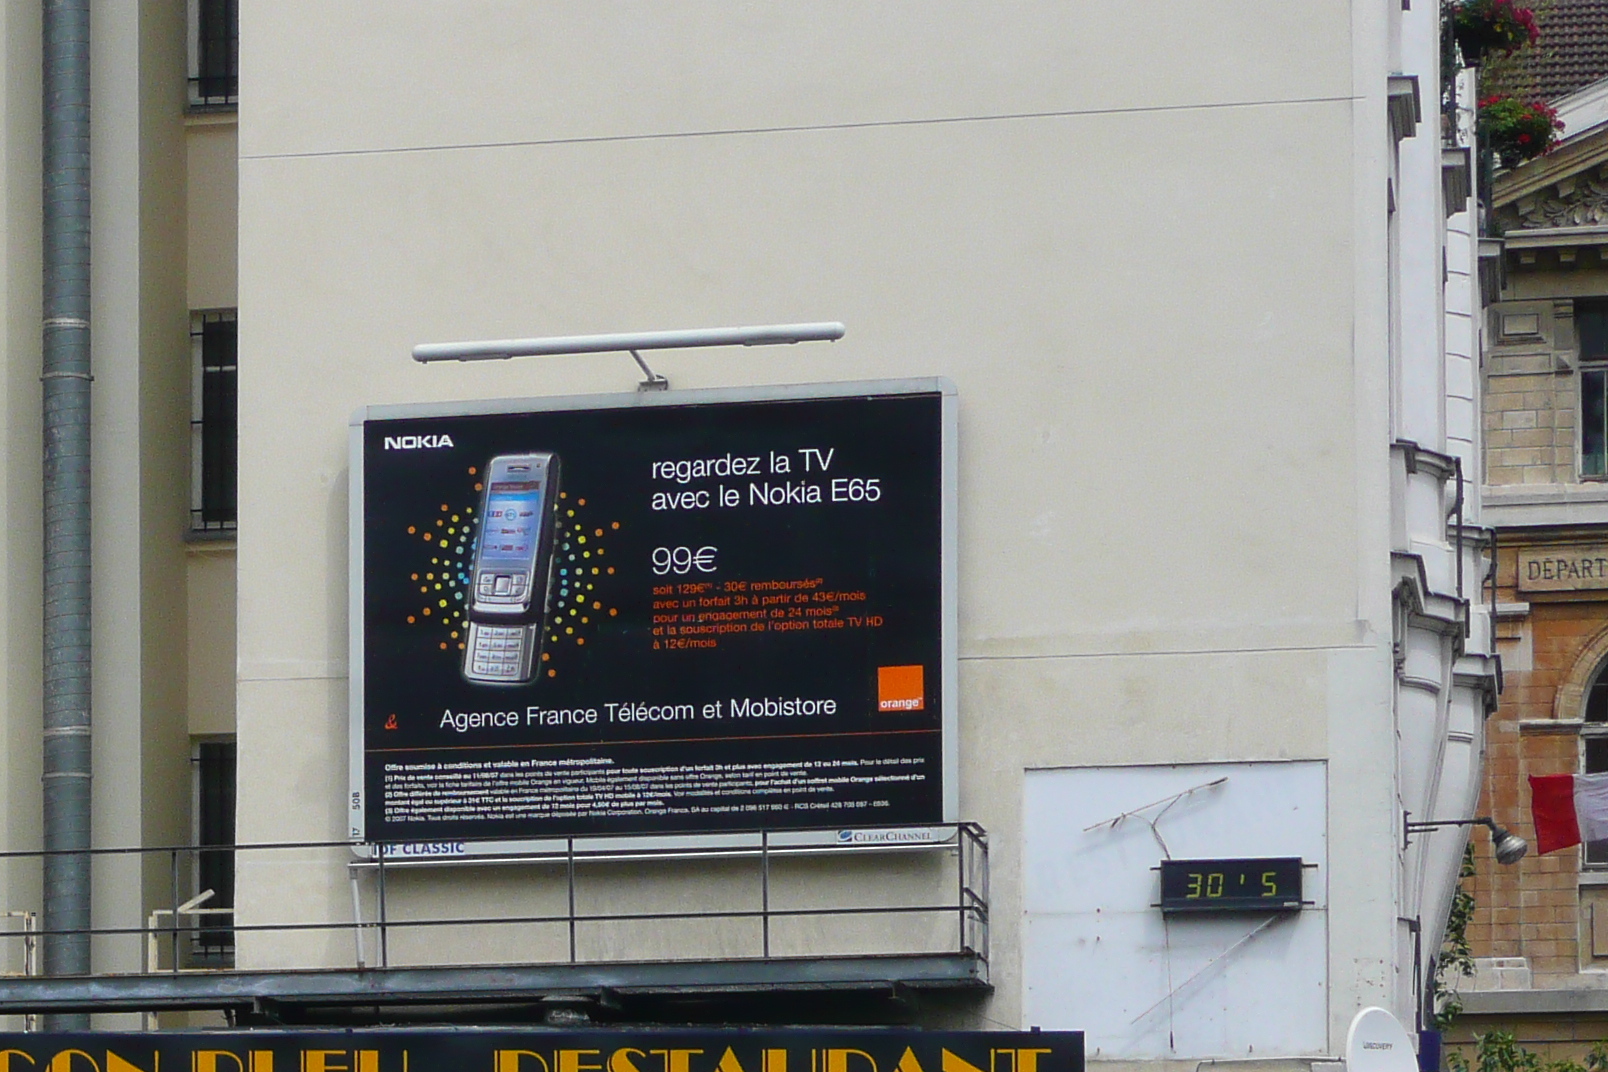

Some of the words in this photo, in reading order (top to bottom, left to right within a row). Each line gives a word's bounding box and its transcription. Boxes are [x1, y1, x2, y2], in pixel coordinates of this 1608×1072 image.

[384, 434, 454, 450] NOKIA
[652, 452, 761, 484] regardez
[770, 451, 791, 474] la
[798, 448, 834, 472] TV
[652, 490, 710, 510] avec
[719, 484, 739, 507] le
[750, 480, 822, 506] Nokia
[831, 478, 881, 502] E65
[652, 546, 718, 575] 99€
[653, 585, 673, 595] soit
[724, 581, 747, 592] 30€
[653, 600, 679, 609] avec
[682, 599, 696, 608] un
[699, 596, 730, 607] forfait
[734, 595, 748, 605] 3h
[752, 595, 758, 605] à
[762, 593, 791, 606] partir
[794, 593, 808, 603] de
[812, 591, 866, 602] 43€/mois
[653, 614, 678, 623] pour
[682, 614, 695, 622] un
[698, 609, 767, 621] engagement
[770, 608, 785, 618] de
[788, 607, 802, 617] 24
[653, 626, 663, 635] et
[667, 625, 676, 635] la
[680, 623, 747, 635] souscription
[750, 622, 765, 632] de
[813, 618, 844, 629] totale
[847, 616, 862, 627] TV
[866, 615, 883, 626] HD
[653, 640, 660, 649] à
[664, 638, 717, 649] 12€/mois
[880, 697, 920, 710] orange
[440, 709, 519, 733] Agence
[526, 706, 597, 726] France
[604, 701, 694, 722] Télécom
[702, 701, 722, 719] et
[731, 697, 836, 718] Mobistore
[403, 842, 465, 854] CLASSIC
